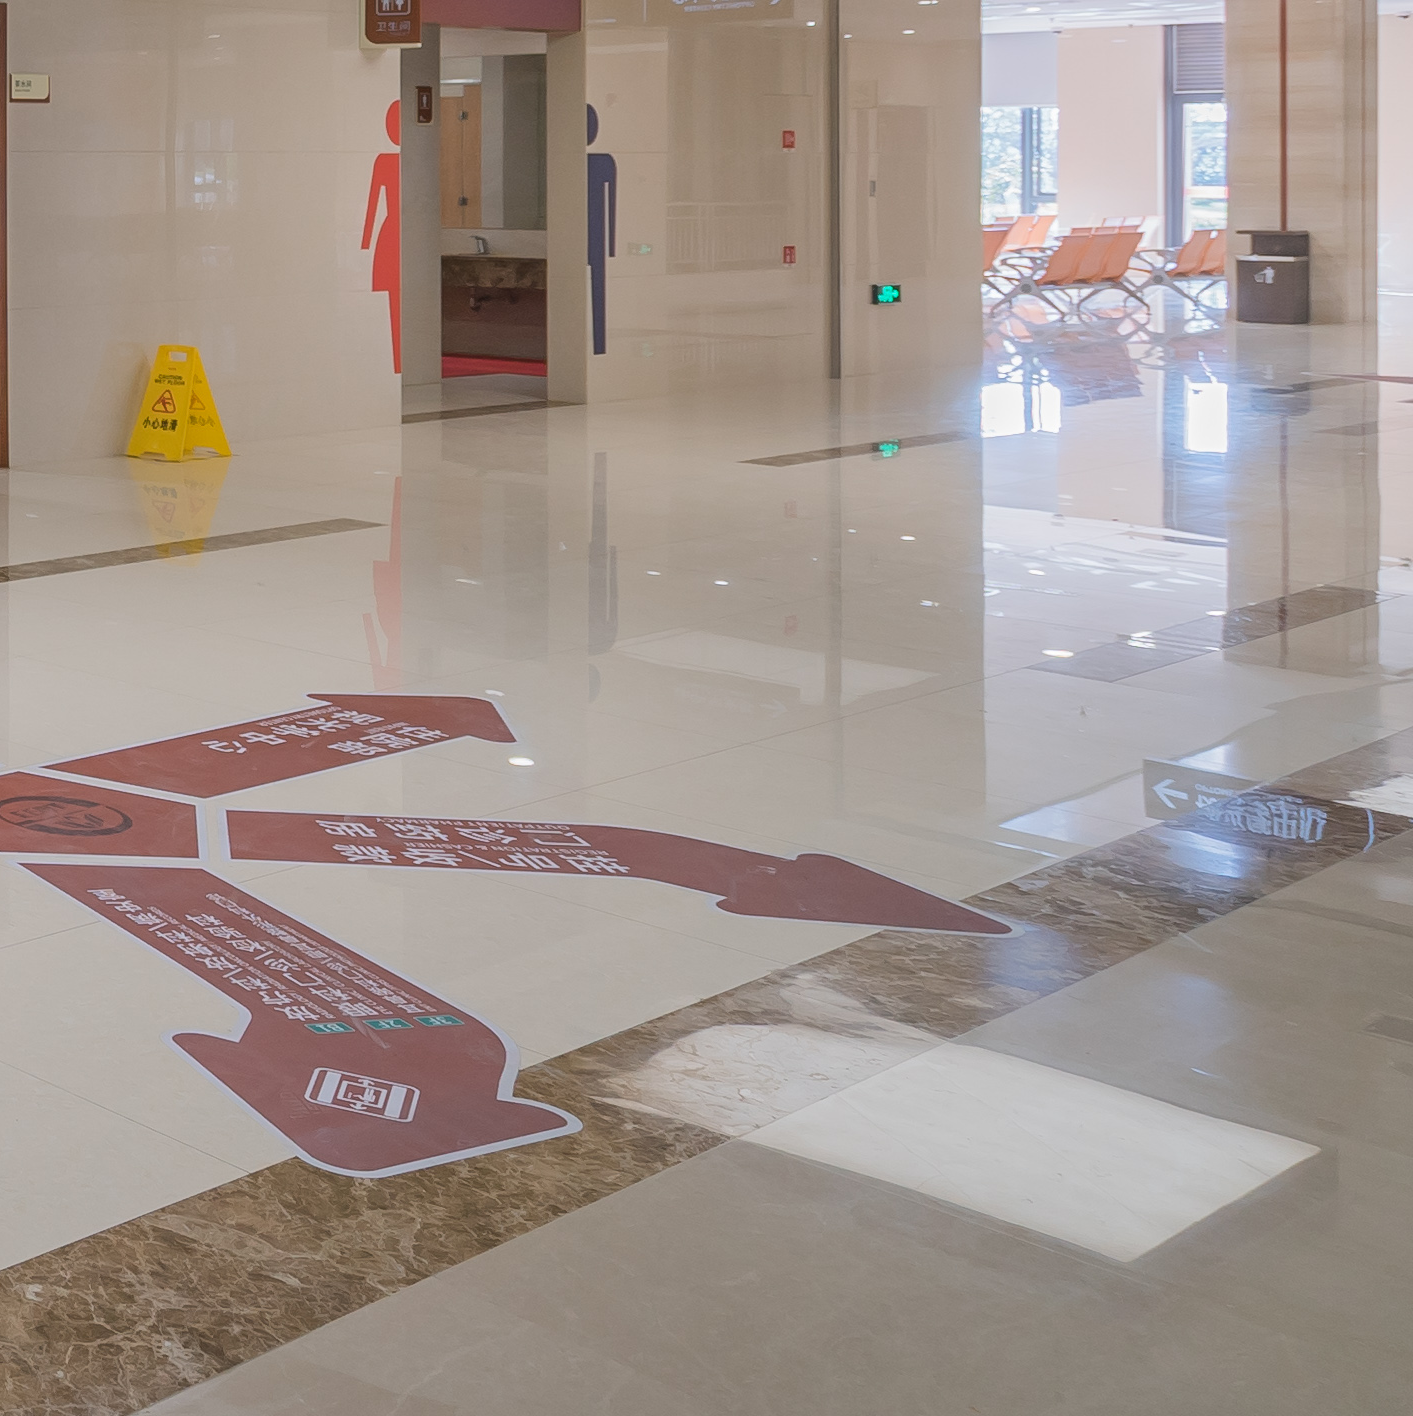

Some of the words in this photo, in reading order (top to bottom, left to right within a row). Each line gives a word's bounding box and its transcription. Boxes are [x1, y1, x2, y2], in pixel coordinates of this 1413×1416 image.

[376, 21, 410, 32] 卫生间
[143, 416, 178, 432] 小心地滑
[200, 710, 384, 754] 视光学中心
[327, 726, 449, 756] 住院部
[314, 820, 591, 847] 门诊药房
[332, 843, 630, 873] 挂号/收款
